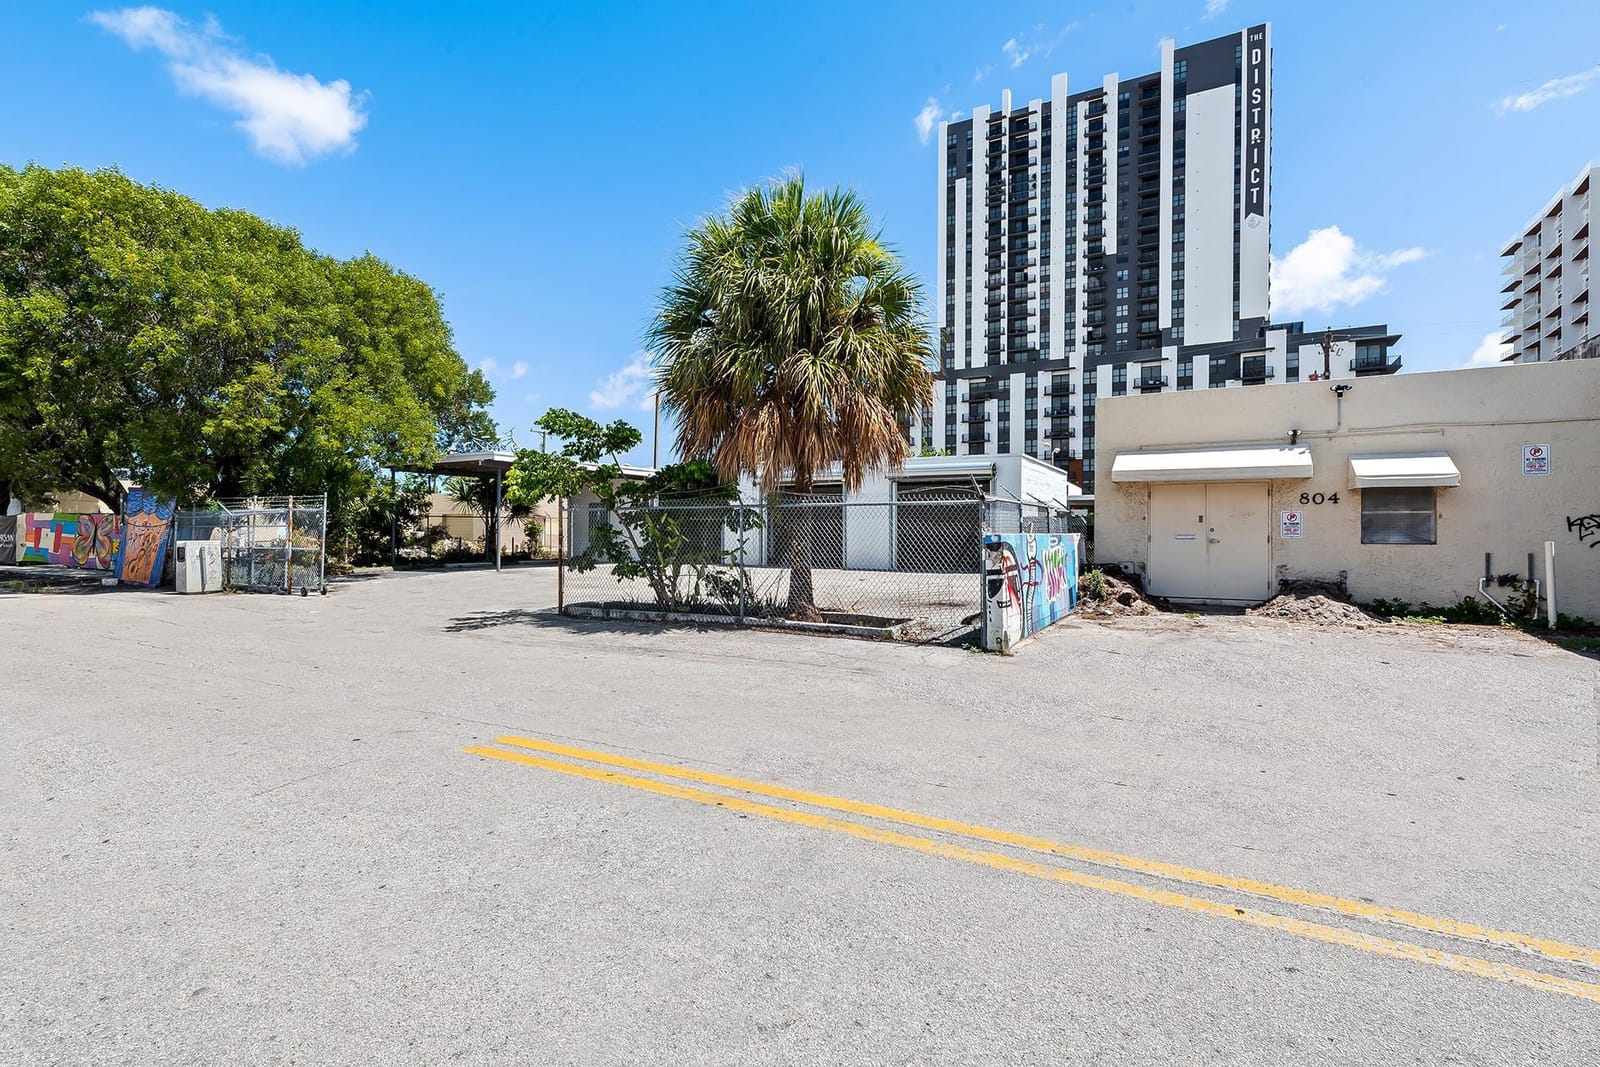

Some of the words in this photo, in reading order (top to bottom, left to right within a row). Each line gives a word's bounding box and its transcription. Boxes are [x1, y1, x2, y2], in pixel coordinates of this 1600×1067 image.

[1250, 32, 1263, 42] THE
[1250, 48, 1261, 204] DISTRICT
[1299, 492, 1340, 505] 804
